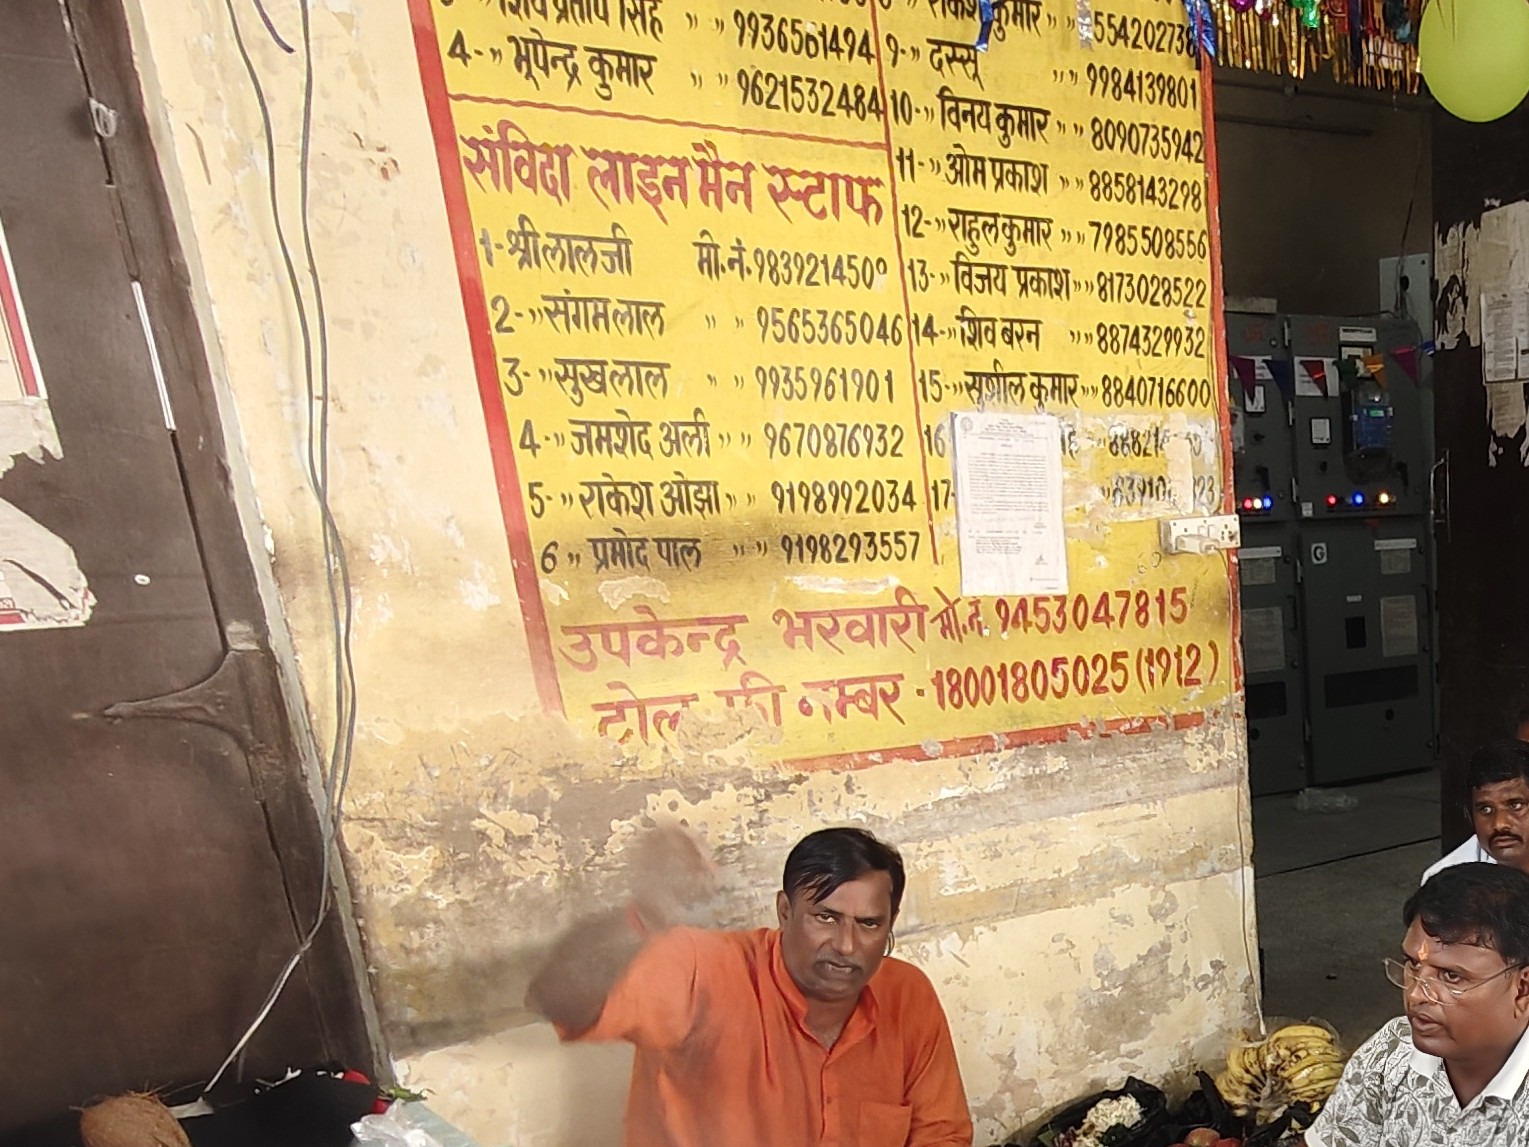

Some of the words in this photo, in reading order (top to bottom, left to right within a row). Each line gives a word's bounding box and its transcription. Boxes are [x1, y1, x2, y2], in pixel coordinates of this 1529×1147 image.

[734, 9, 875, 65] 9936561494
[1083, 10, 1196, 58] 554202738
[583, 46, 657, 101] कुमार
[737, 69, 884, 122] 9621532484
[1086, 62, 1197, 109] 9984139801
[936, 86, 992, 134] विनय
[995, 103, 1050, 148] कुमार
[1090, 116, 1204, 164] 8090735942
[461, 120, 576, 202] संविदा
[762, 162, 885, 227] स्टाफ
[945, 143, 987, 190] ओम
[989, 157, 1049, 195] प्रकाश
[1089, 169, 1202, 212] 8858143298
[1001, 213, 1054, 257] कुमार
[1088, 220, 1207, 260] 7985508556
[950, 251, 1009, 297] विजय
[1011, 264, 1071, 301] प्रकाश
[1096, 270, 1207, 309] 8173028522
[757, 306, 902, 346] 9565365046
[1096, 321, 1206, 359] 8874329932
[755, 364, 894, 404] 9935961901
[1101, 374, 1211, 408] 8840716600
[569, 408, 653, 460] जमशेद
[659, 407, 711, 459] अली
[764, 422, 904, 460] 9670876932
[579, 473, 655, 520] राकेश
[660, 471, 720, 519] ओझा
[771, 479, 917, 517] 9198992034
[588, 527, 649, 573] प्रमोद
[652, 537, 702, 571] पाल
[781, 531, 920, 566] 9198293557
[559, 605, 749, 672] उपकेन्द्र
[773, 585, 929, 654] भरवारी
[995, 586, 1188, 634] 9453047815
